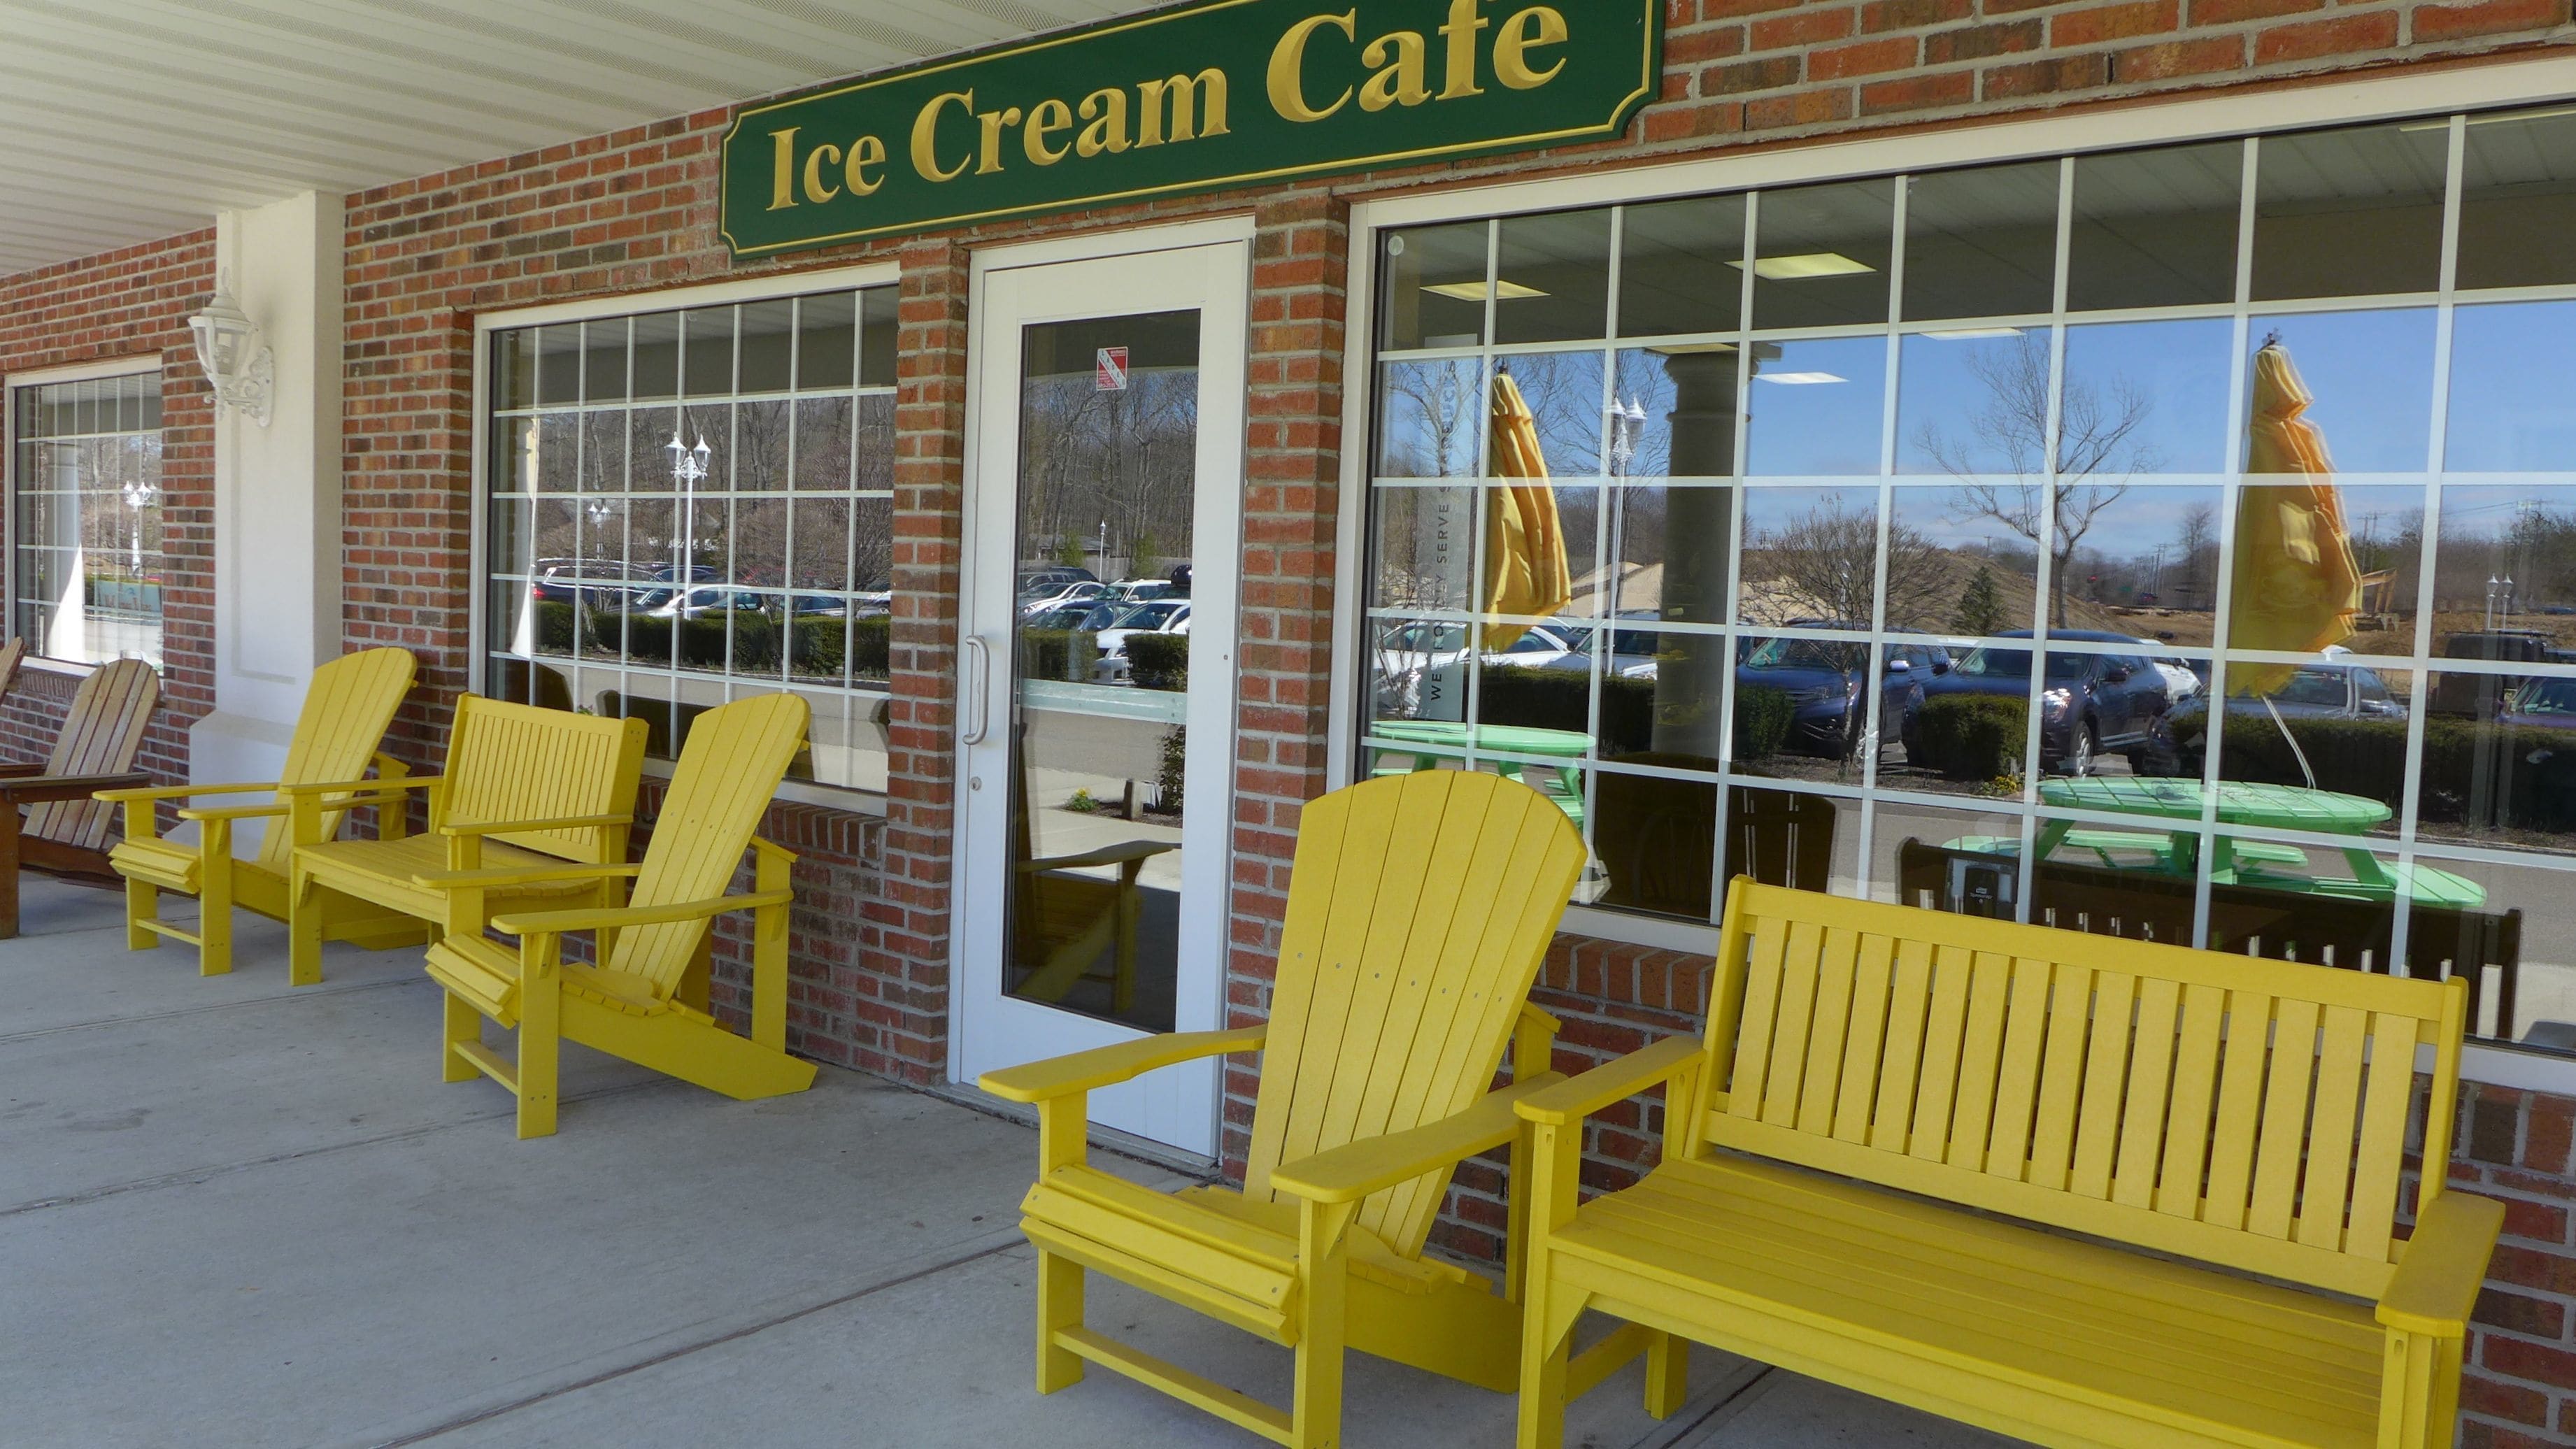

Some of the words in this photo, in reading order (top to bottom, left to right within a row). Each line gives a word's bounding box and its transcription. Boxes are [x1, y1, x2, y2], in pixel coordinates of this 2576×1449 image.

[766, 127, 885, 211] Ice
[910, 68, 1231, 183] Cream
[1266, 0, 1567, 122] Cafe
[1437, 504, 1450, 564] SERVE
[1434, 574, 1446, 662] RODLY
[1431, 673, 1442, 701] WE
